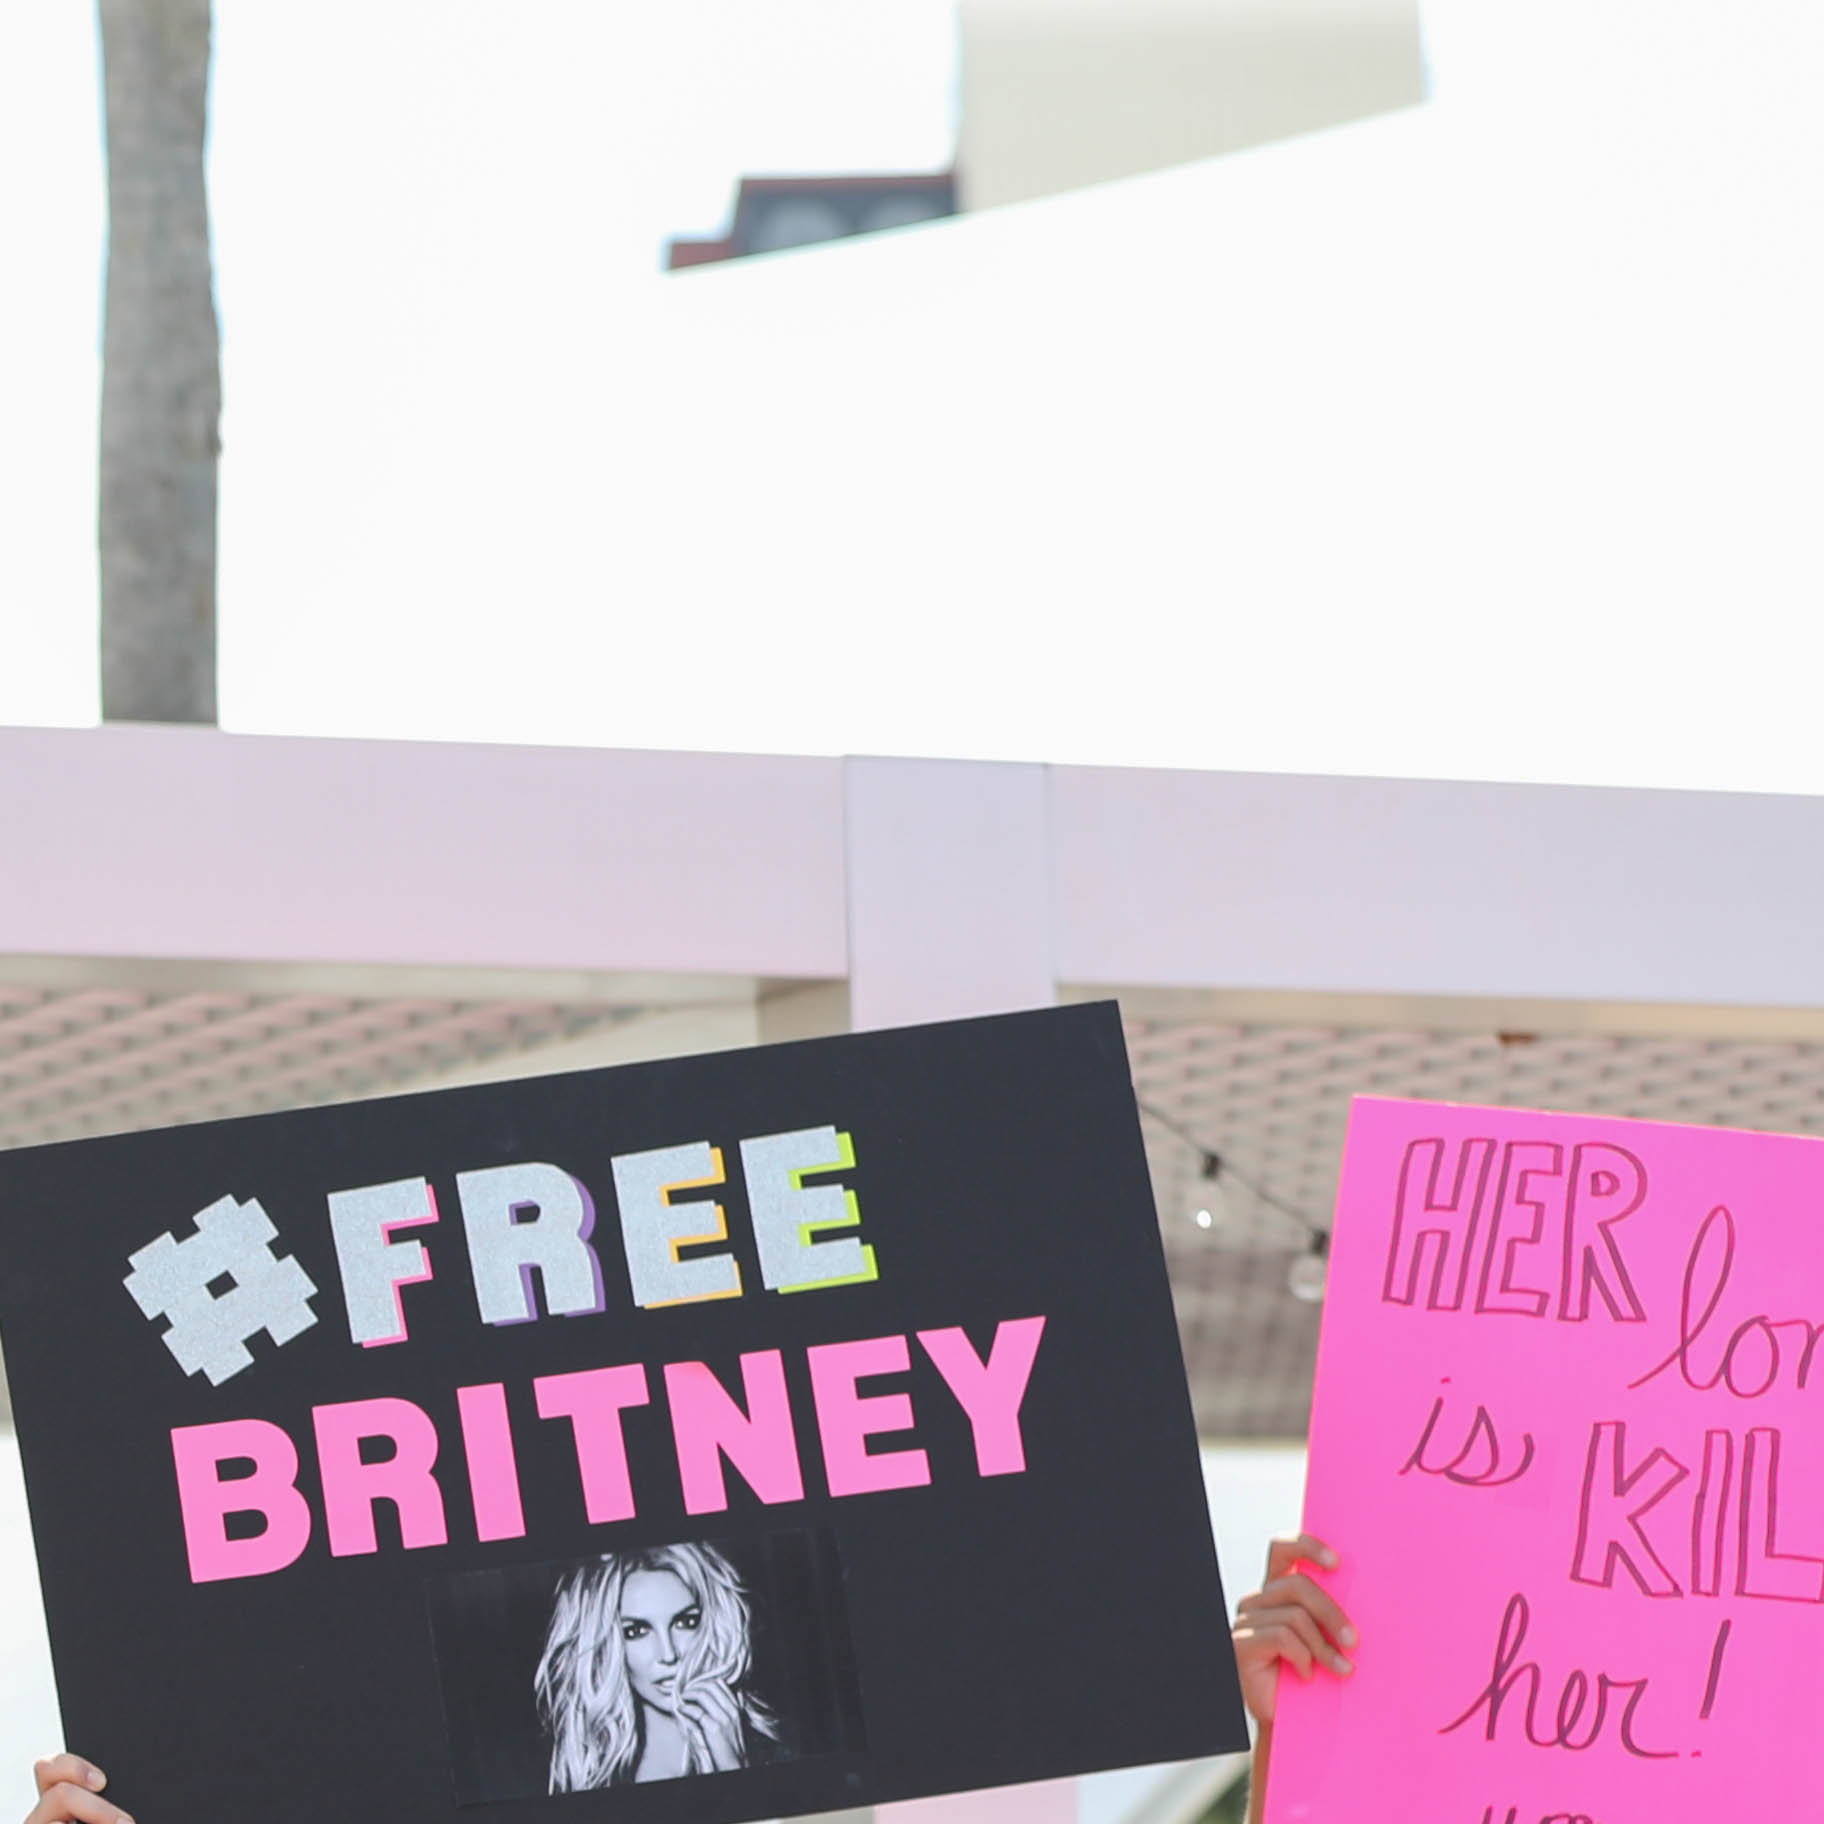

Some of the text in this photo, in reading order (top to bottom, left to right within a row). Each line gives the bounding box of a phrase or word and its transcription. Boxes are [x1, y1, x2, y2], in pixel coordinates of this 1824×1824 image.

[123, 1125, 878, 1388] #FREE
[1382, 1138, 1647, 1321] HER
[171, 1315, 1046, 1584] BRITNEY
[1399, 1378, 1535, 1486] is
[1438, 1593, 1731, 1759] her!
